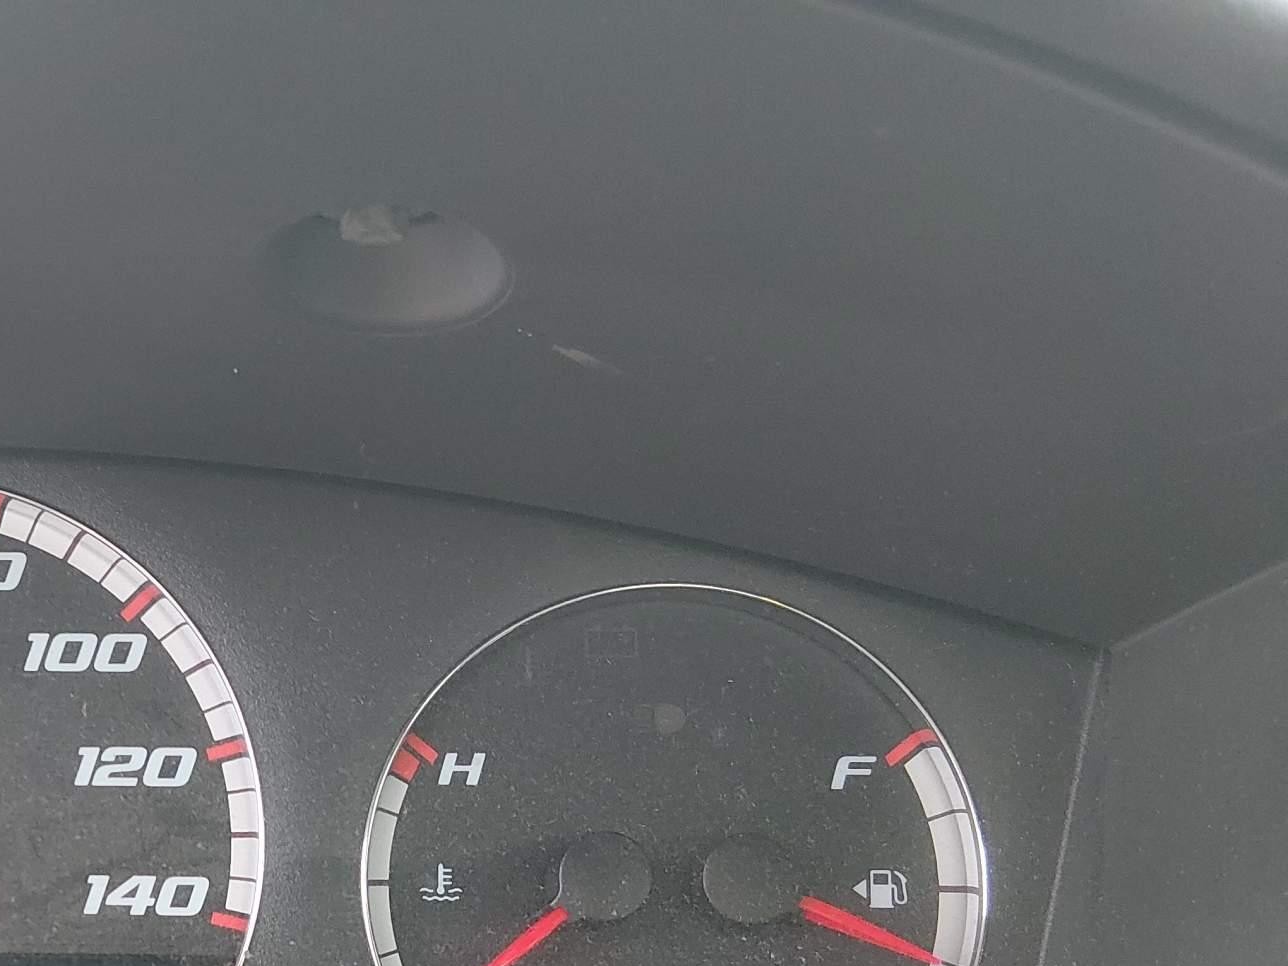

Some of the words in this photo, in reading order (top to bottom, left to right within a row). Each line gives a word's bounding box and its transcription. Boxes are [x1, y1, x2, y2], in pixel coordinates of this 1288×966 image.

[22, 632, 148, 673] 100
[73, 746, 198, 787] 120
[437, 752, 487, 786] H
[830, 755, 878, 791] F
[82, 874, 209, 917] 140
